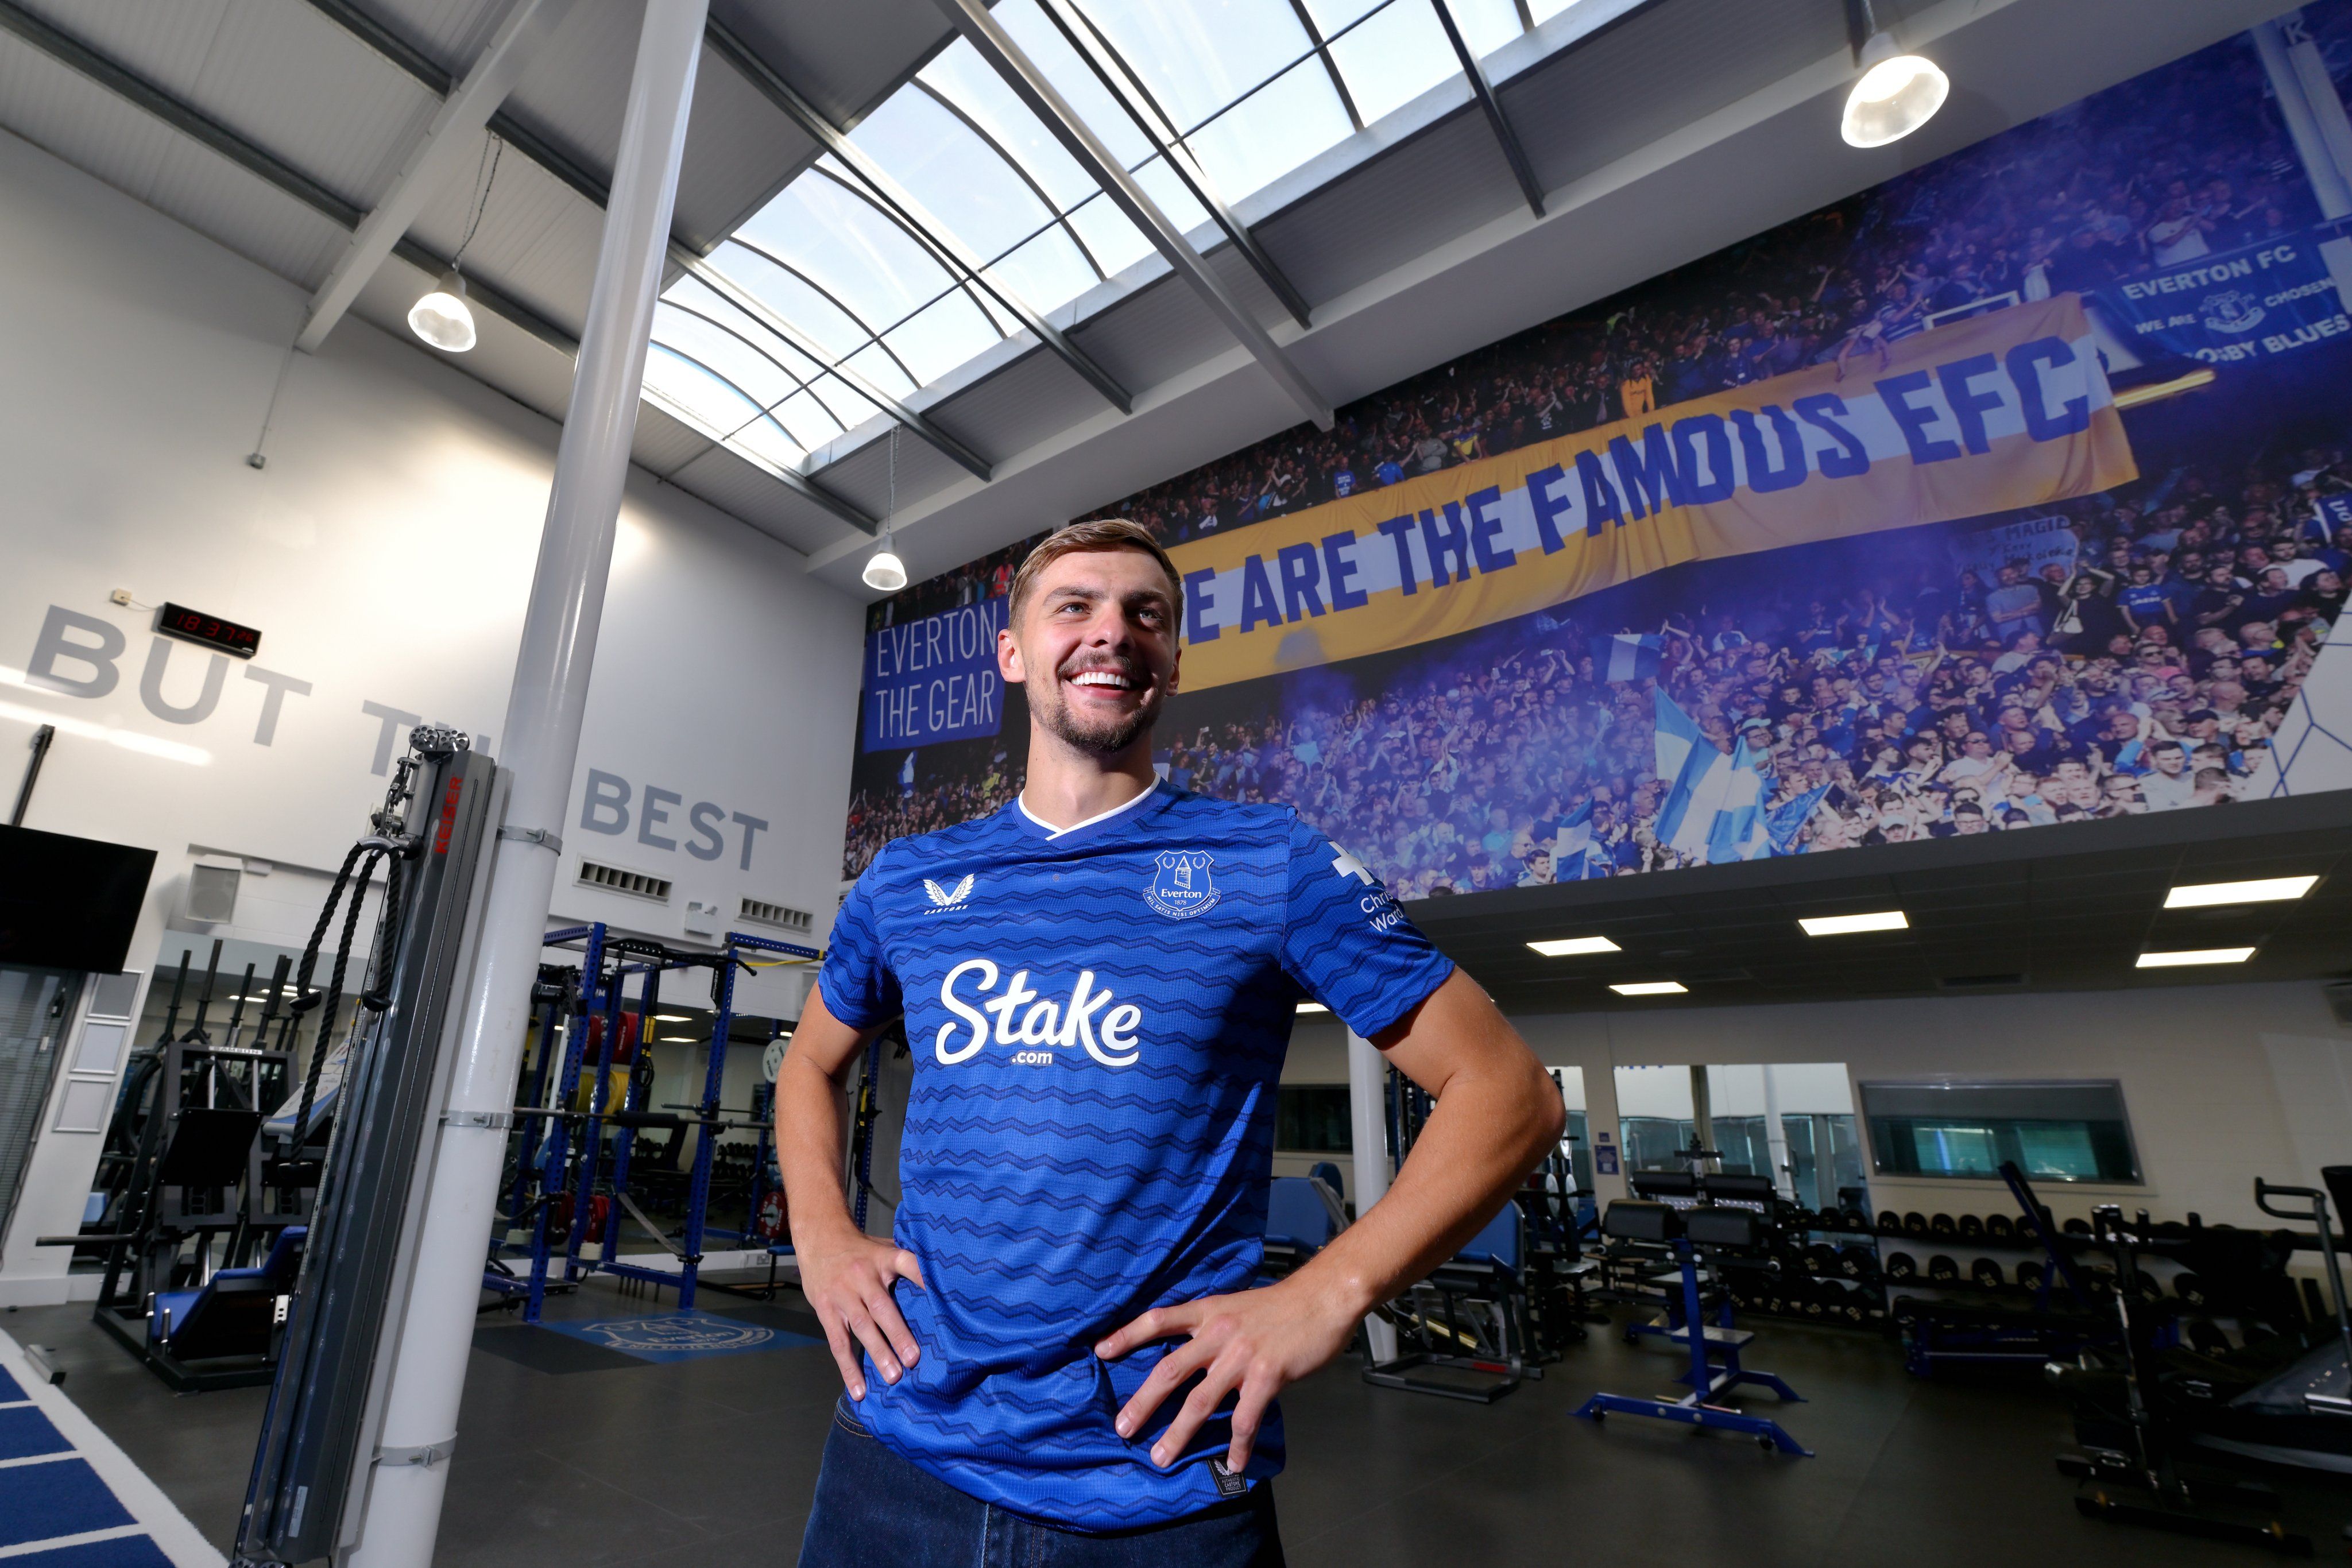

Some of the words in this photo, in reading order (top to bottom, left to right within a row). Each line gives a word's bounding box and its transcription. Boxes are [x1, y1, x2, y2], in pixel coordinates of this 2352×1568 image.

[2122, 258, 2253, 300] EVERTON
[2256, 245, 2296, 269] FC
[2135, 319, 2165, 334] WE
[2183, 340, 2258, 363] OSBY
[2261, 313, 2351, 354] BLUES
[1184, 567, 1220, 645] E
[1240, 529, 1368, 634] ARE
[1378, 485, 1517, 596] THE
[1525, 393, 1870, 556] FAMOUS
[1875, 336, 2090, 466] EFC
[876, 598, 998, 677] EVERTON
[24, 605, 314, 748] BUT
[876, 681, 922, 739] THE
[928, 669, 995, 733] GEAR
[435, 776, 463, 855] KEISER
[581, 768, 769, 872] BEST
[1146, 896, 1154, 905] NIL
[1154, 904, 1171, 915] SATIS
[1189, 898, 1216, 915] OPTIMUM
[1161, 888, 1202, 899] Everton
[1360, 891, 1394, 913] Chris
[1369, 904, 1404, 932] Ward
[935, 958, 1140, 1066] Stake
[1011, 1050, 1053, 1065] .com
